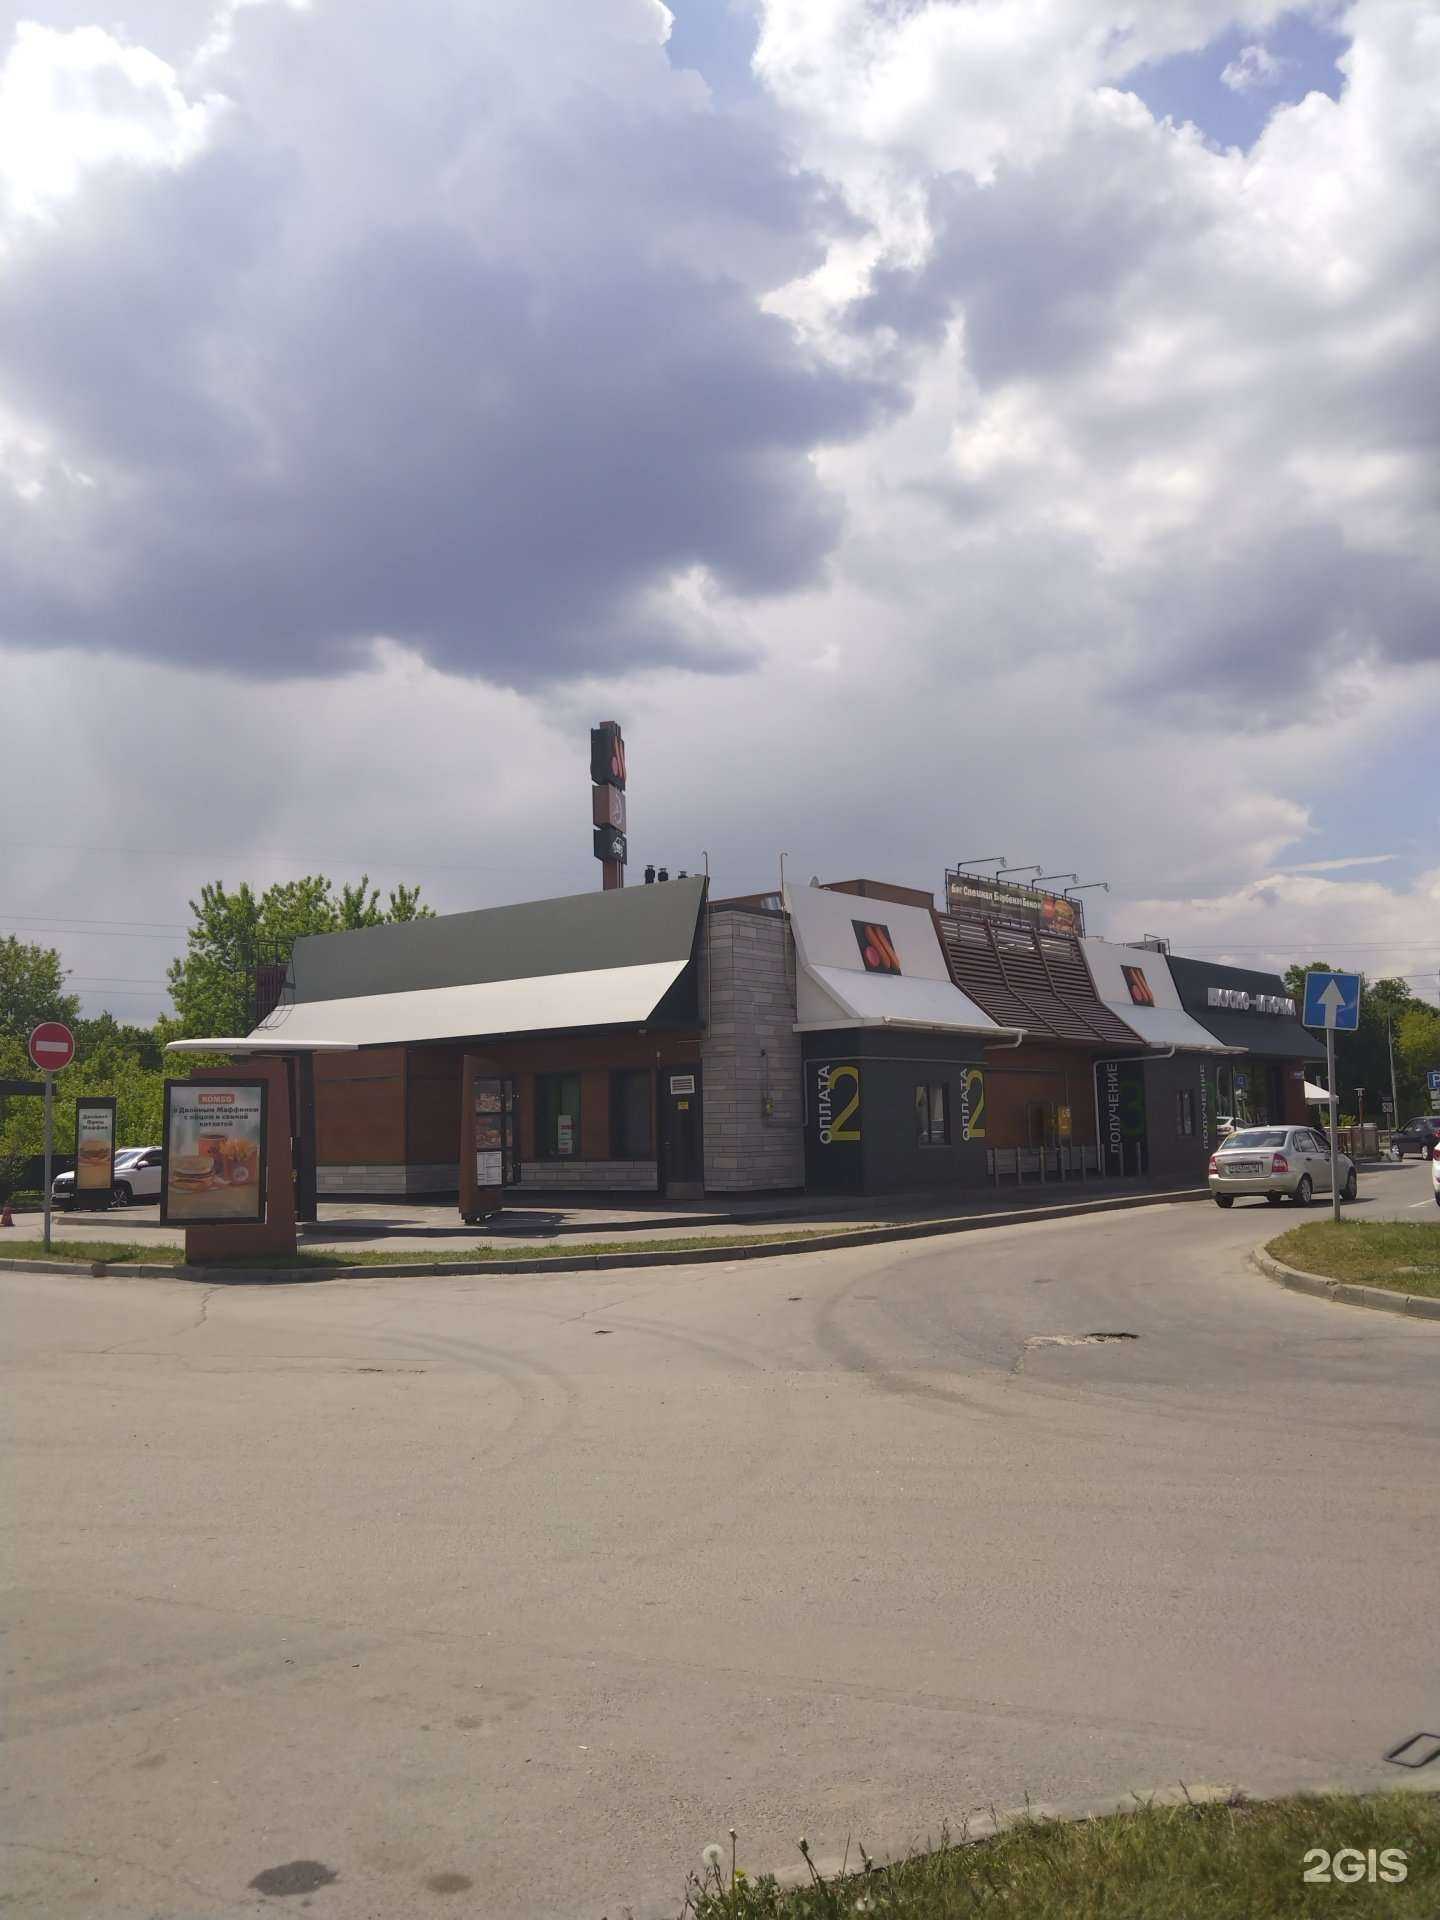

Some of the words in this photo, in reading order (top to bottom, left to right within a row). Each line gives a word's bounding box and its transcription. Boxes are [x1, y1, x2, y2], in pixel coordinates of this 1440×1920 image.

[817, 1064, 832, 1144] ОПЛАТА
[828, 1066, 861, 1141] 2
[960, 1067, 970, 1141] ОПЛАТА
[967, 1069, 986, 1138] 2
[1106, 1063, 1121, 1153] ПОЛУЧЕНИЕ
